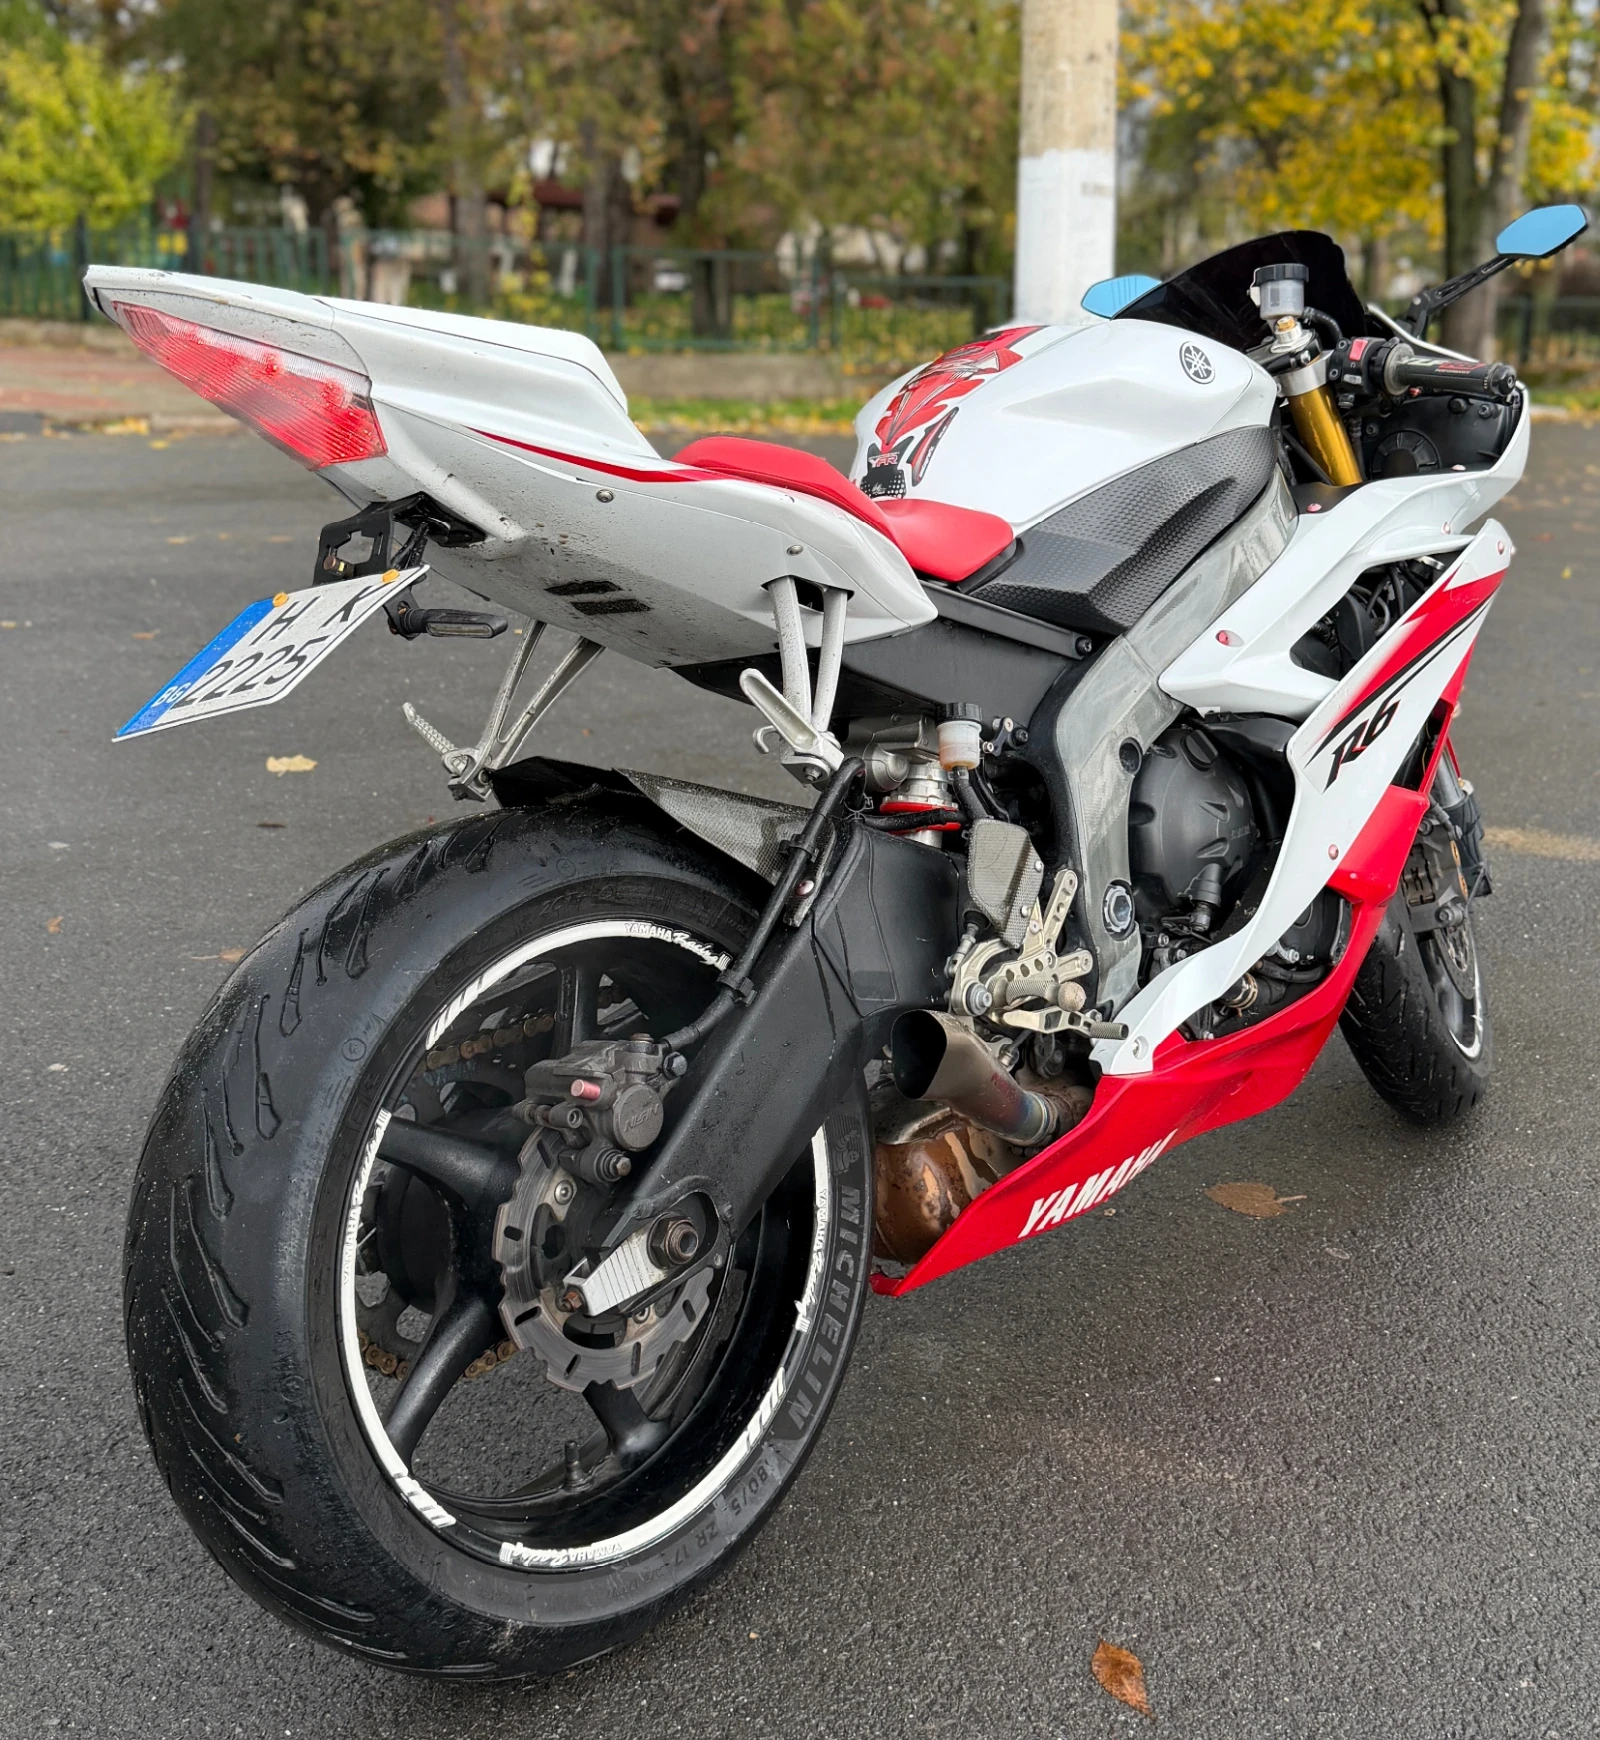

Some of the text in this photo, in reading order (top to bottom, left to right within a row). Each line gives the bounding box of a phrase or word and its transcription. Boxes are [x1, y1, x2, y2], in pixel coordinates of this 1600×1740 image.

[152, 682, 191, 708] BG
[168, 634, 333, 711] 2225
[1321, 698, 1401, 795] R6
[624, 922, 720, 965] YAMAHA Racing
[1017, 1128, 1179, 1239] YAMAHA
[342, 1205, 362, 1285] YAMAHA
[814, 1188, 829, 1252] YAMAHA
[787, 1184, 862, 1430] MICHELIN
[568, 1541, 623, 1563] YAMAHA
[672, 1547, 691, 1567] 17
[696, 1521, 720, 1551] ZR
